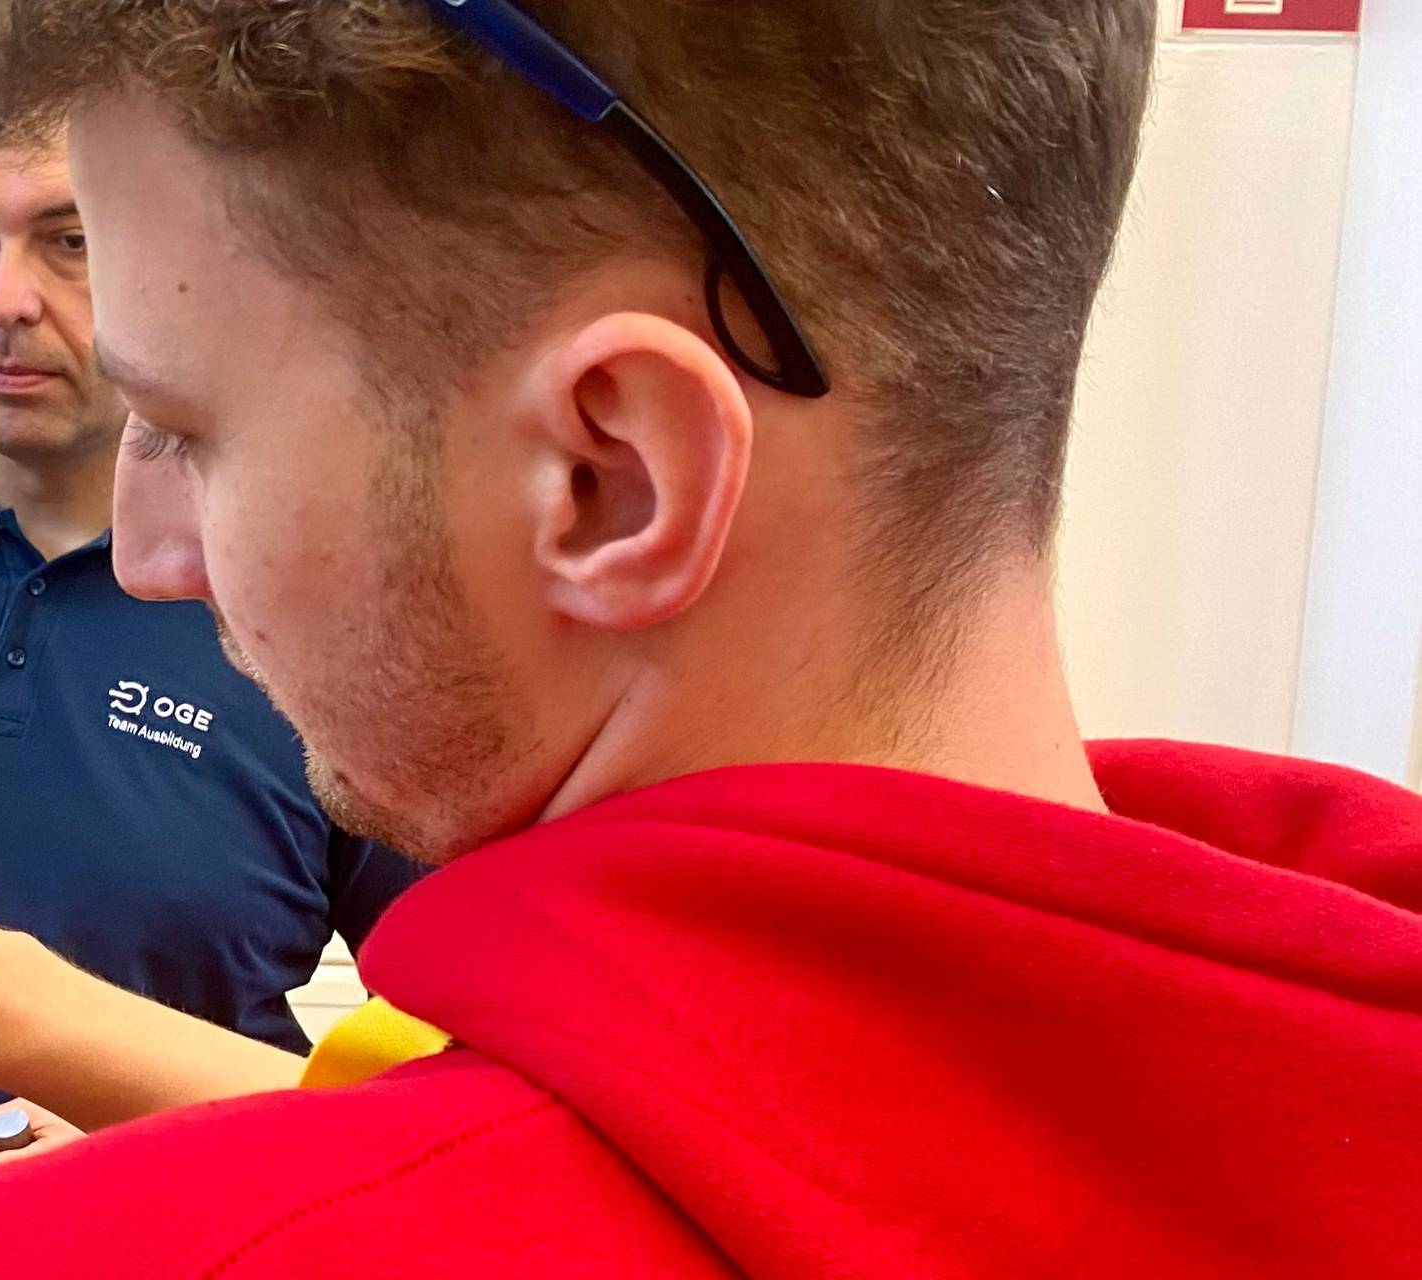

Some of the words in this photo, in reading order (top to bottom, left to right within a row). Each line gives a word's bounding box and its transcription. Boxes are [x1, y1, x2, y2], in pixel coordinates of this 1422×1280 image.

[153, 696, 213, 732] OGE
[108, 714, 138, 734] Team
[138, 725, 202, 759] Ausbildung
